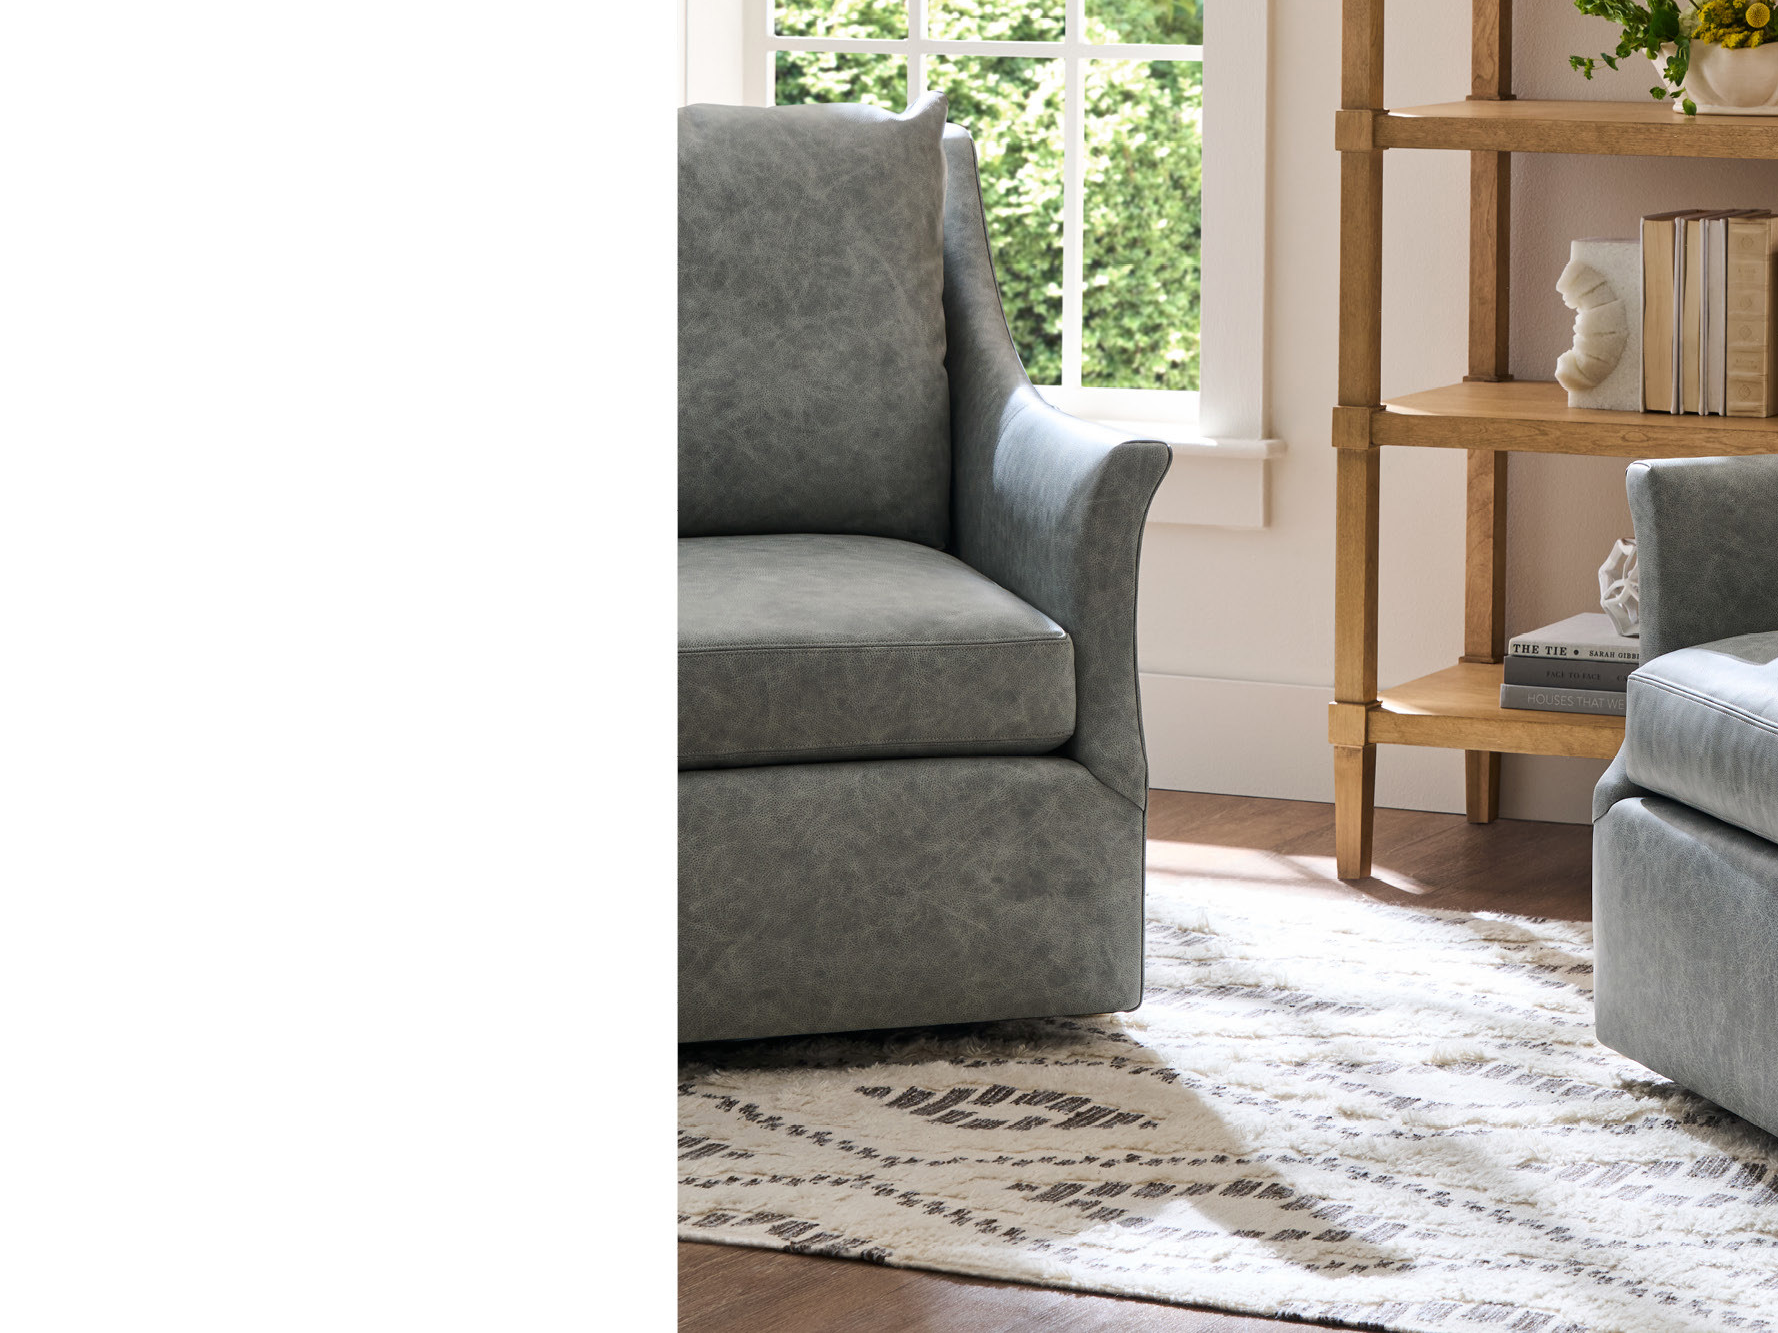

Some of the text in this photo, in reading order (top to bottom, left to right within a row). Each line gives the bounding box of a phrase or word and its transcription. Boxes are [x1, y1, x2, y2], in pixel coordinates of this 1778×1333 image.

[1513, 643, 1539, 654] THE
[1545, 645, 1567, 656] TIE
[1589, 649, 1615, 658] SARAH
[1528, 693, 1625, 710] HOUSES THAT WE
